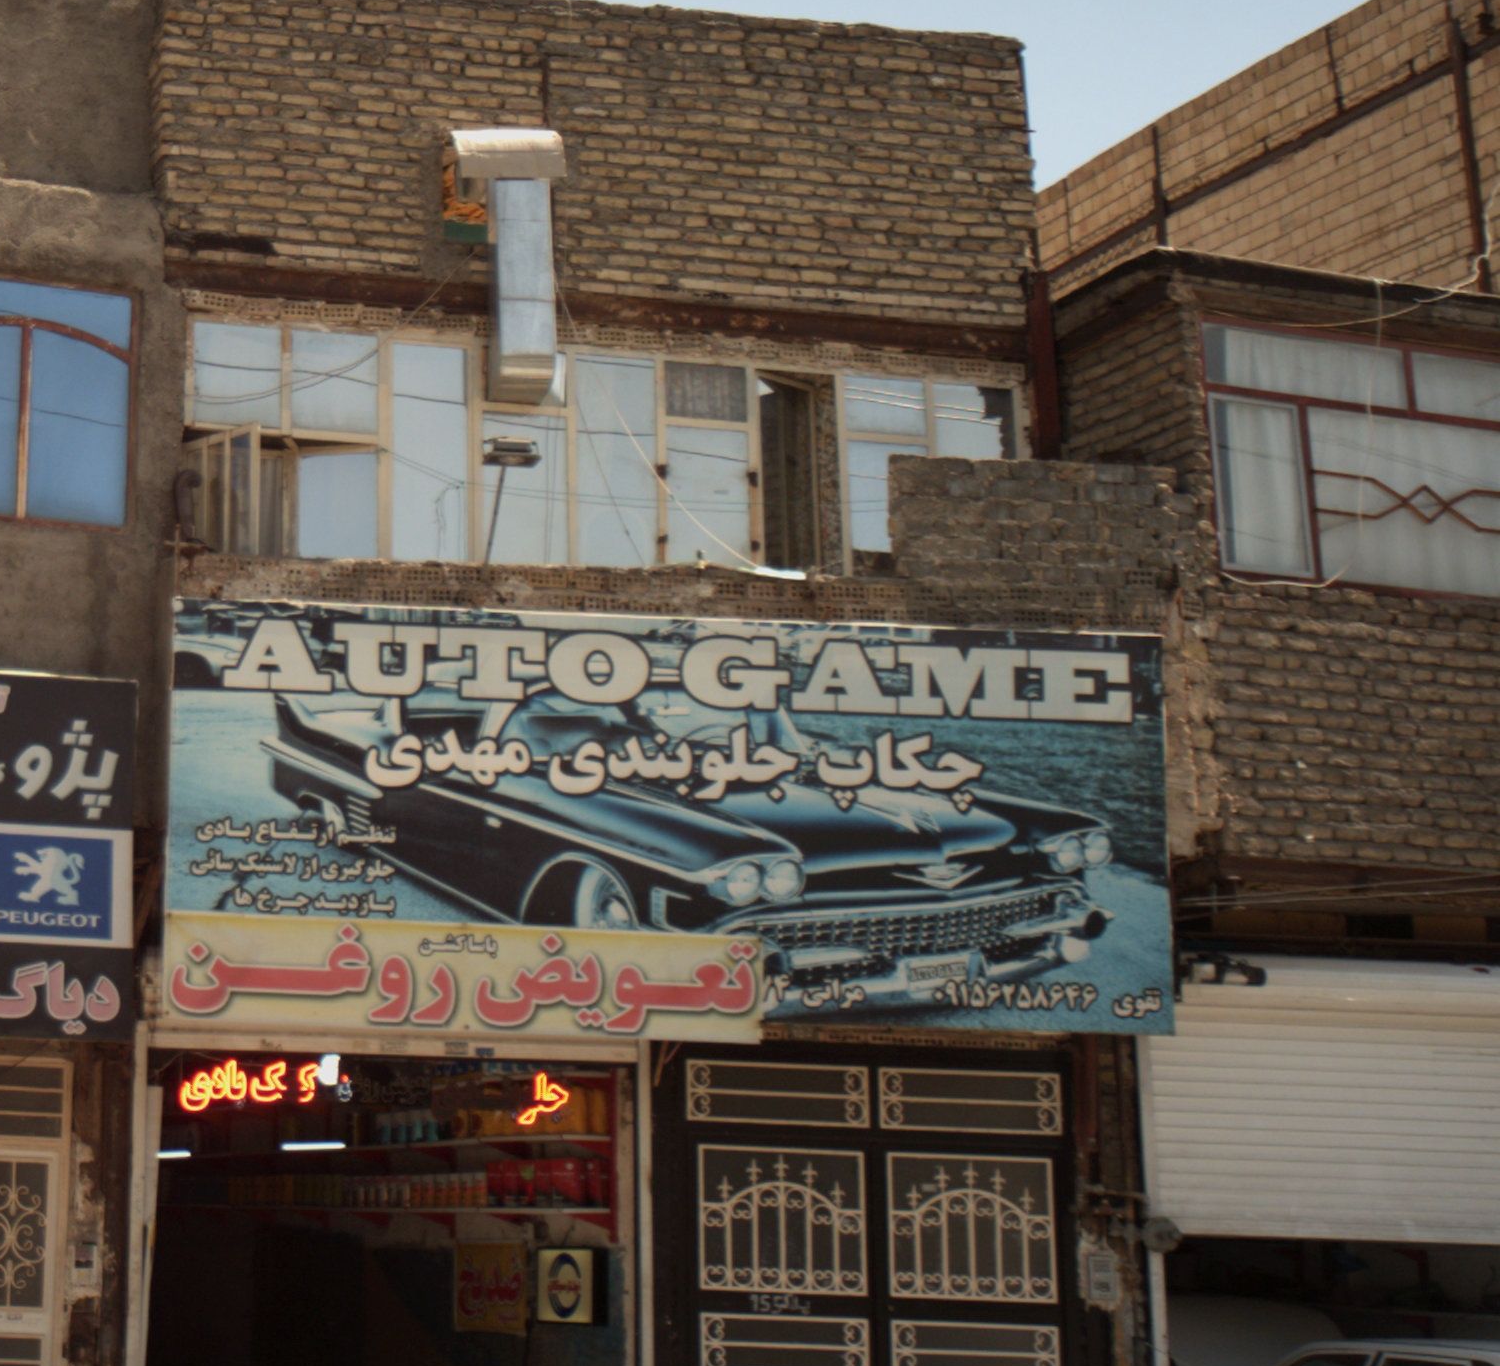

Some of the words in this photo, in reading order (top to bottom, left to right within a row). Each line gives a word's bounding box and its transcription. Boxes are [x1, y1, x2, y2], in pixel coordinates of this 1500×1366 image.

[222, 616, 654, 705] AUTO
[682, 635, 1133, 724] GAME
[364, 729, 533, 790] مهدی
[549, 723, 799, 802] جلوبندی
[815, 731, 984, 812] چکاپ
[196, 817, 251, 842] بادی
[255, 820, 336, 847] ارتفاع
[336, 823, 397, 847] تنظیم
[237, 851, 298, 875] لاستیک
[299, 855, 318, 881] از
[321, 857, 396, 883] جلوگیری
[233, 887, 253, 907] ها
[255, 889, 311, 915] چرخ
[314, 891, 396, 917] بازدید
[170, 923, 456, 1024] روغن
[475, 933, 757, 1032] تعویض
[933, 980, 1098, 1012] ۰۹۱۵۶۲۵۸۶۴۶
[1113, 988, 1163, 1018] تقوی
